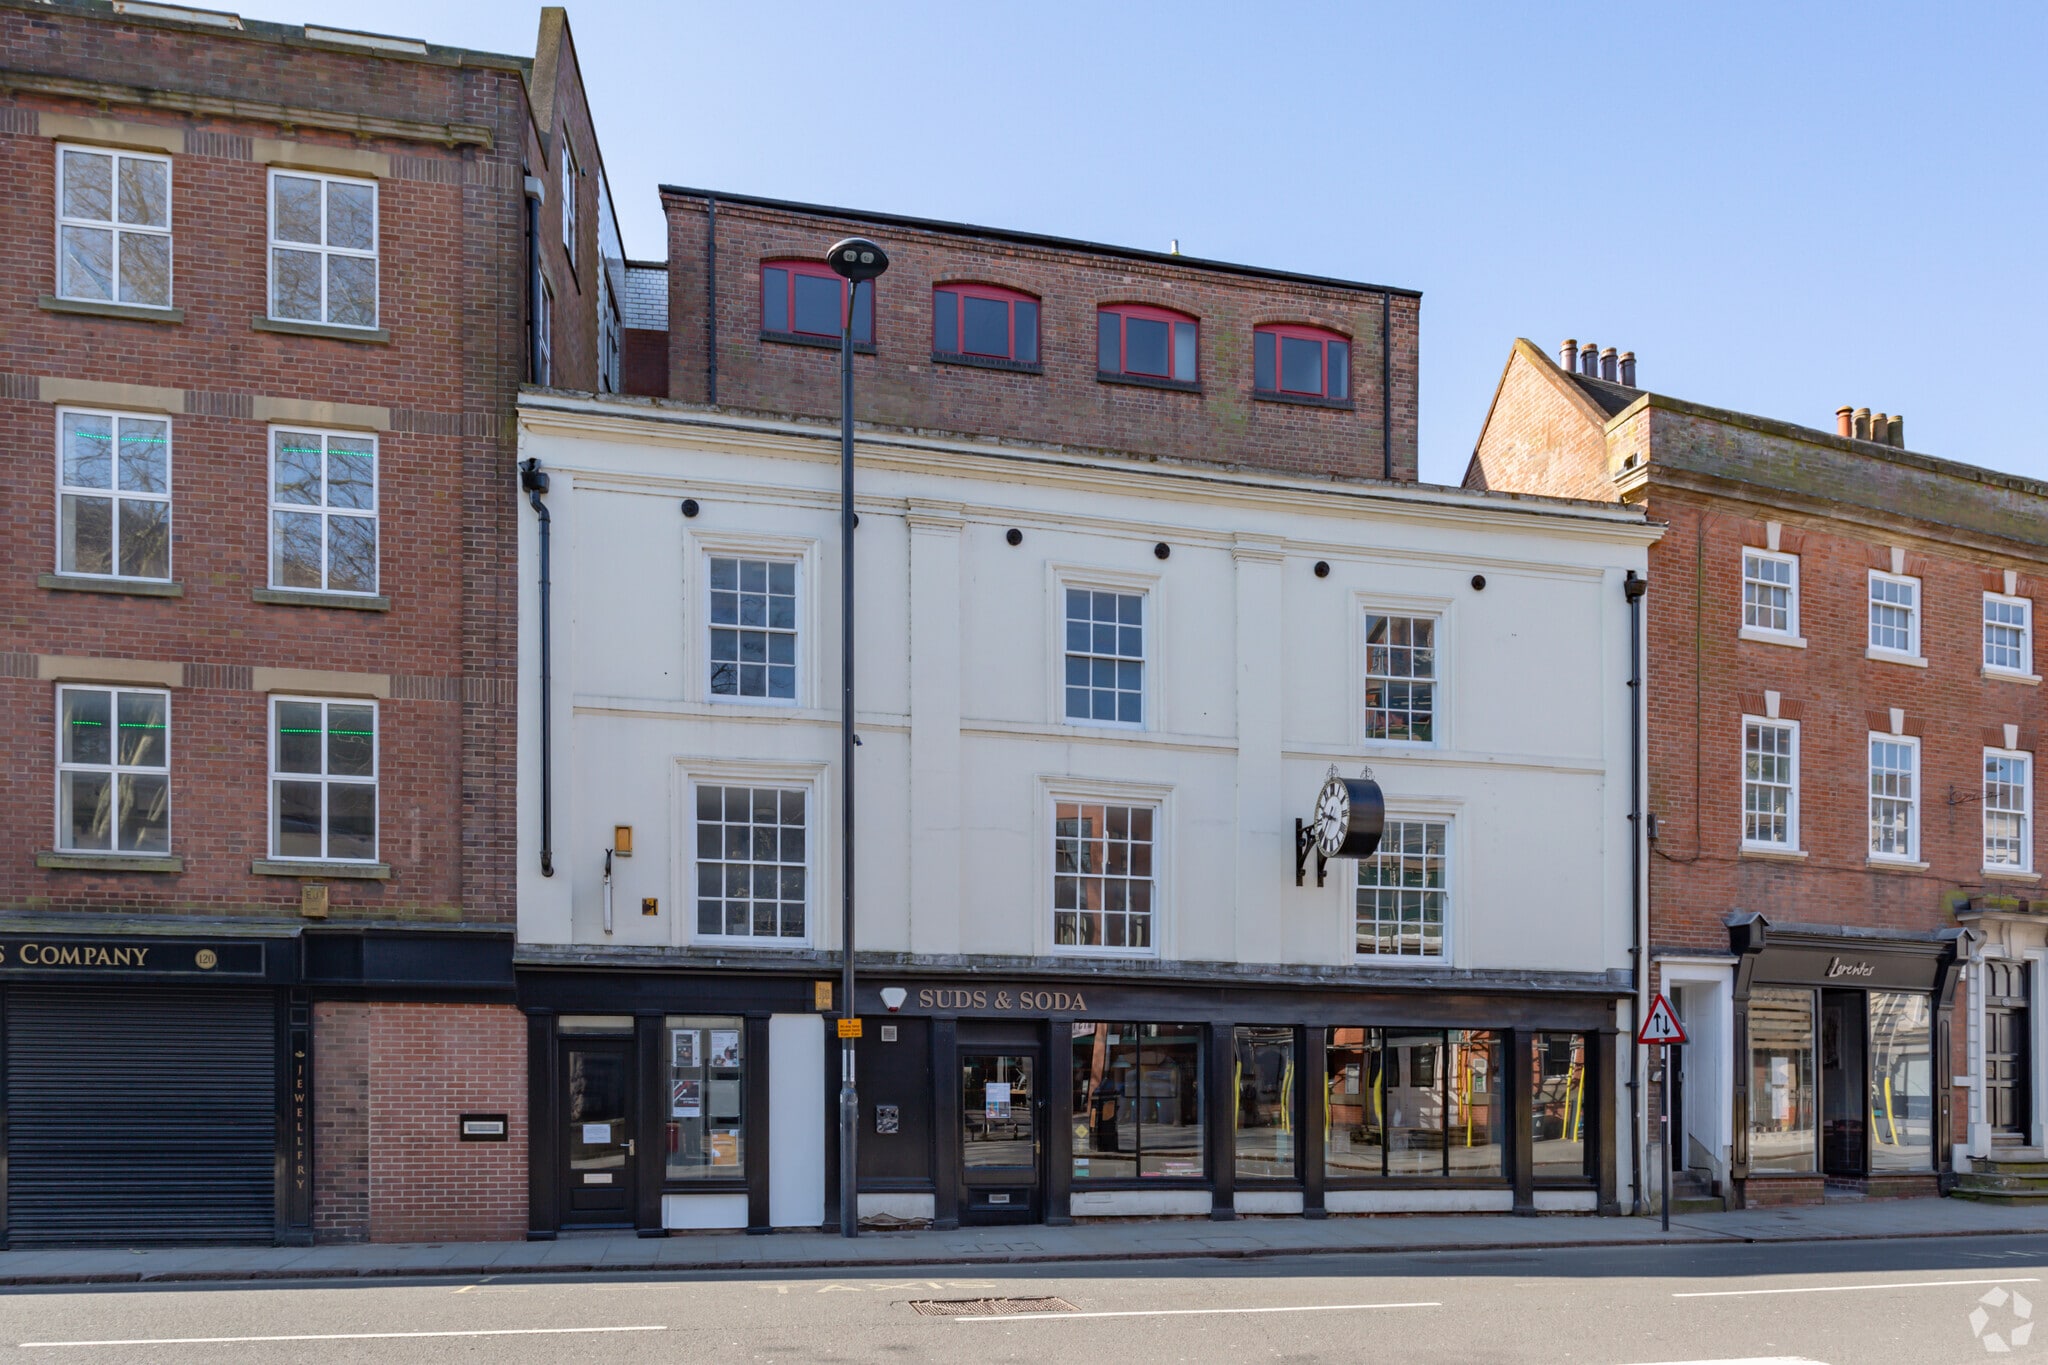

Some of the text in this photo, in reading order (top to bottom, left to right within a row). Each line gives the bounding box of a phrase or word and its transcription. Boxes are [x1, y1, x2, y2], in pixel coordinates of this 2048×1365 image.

[19, 943, 149, 966] COMPANY
[199, 953, 214, 964] 120
[919, 989, 1088, 1011] SUDS & SODA
[757, 1281, 997, 1294] TAXIS
